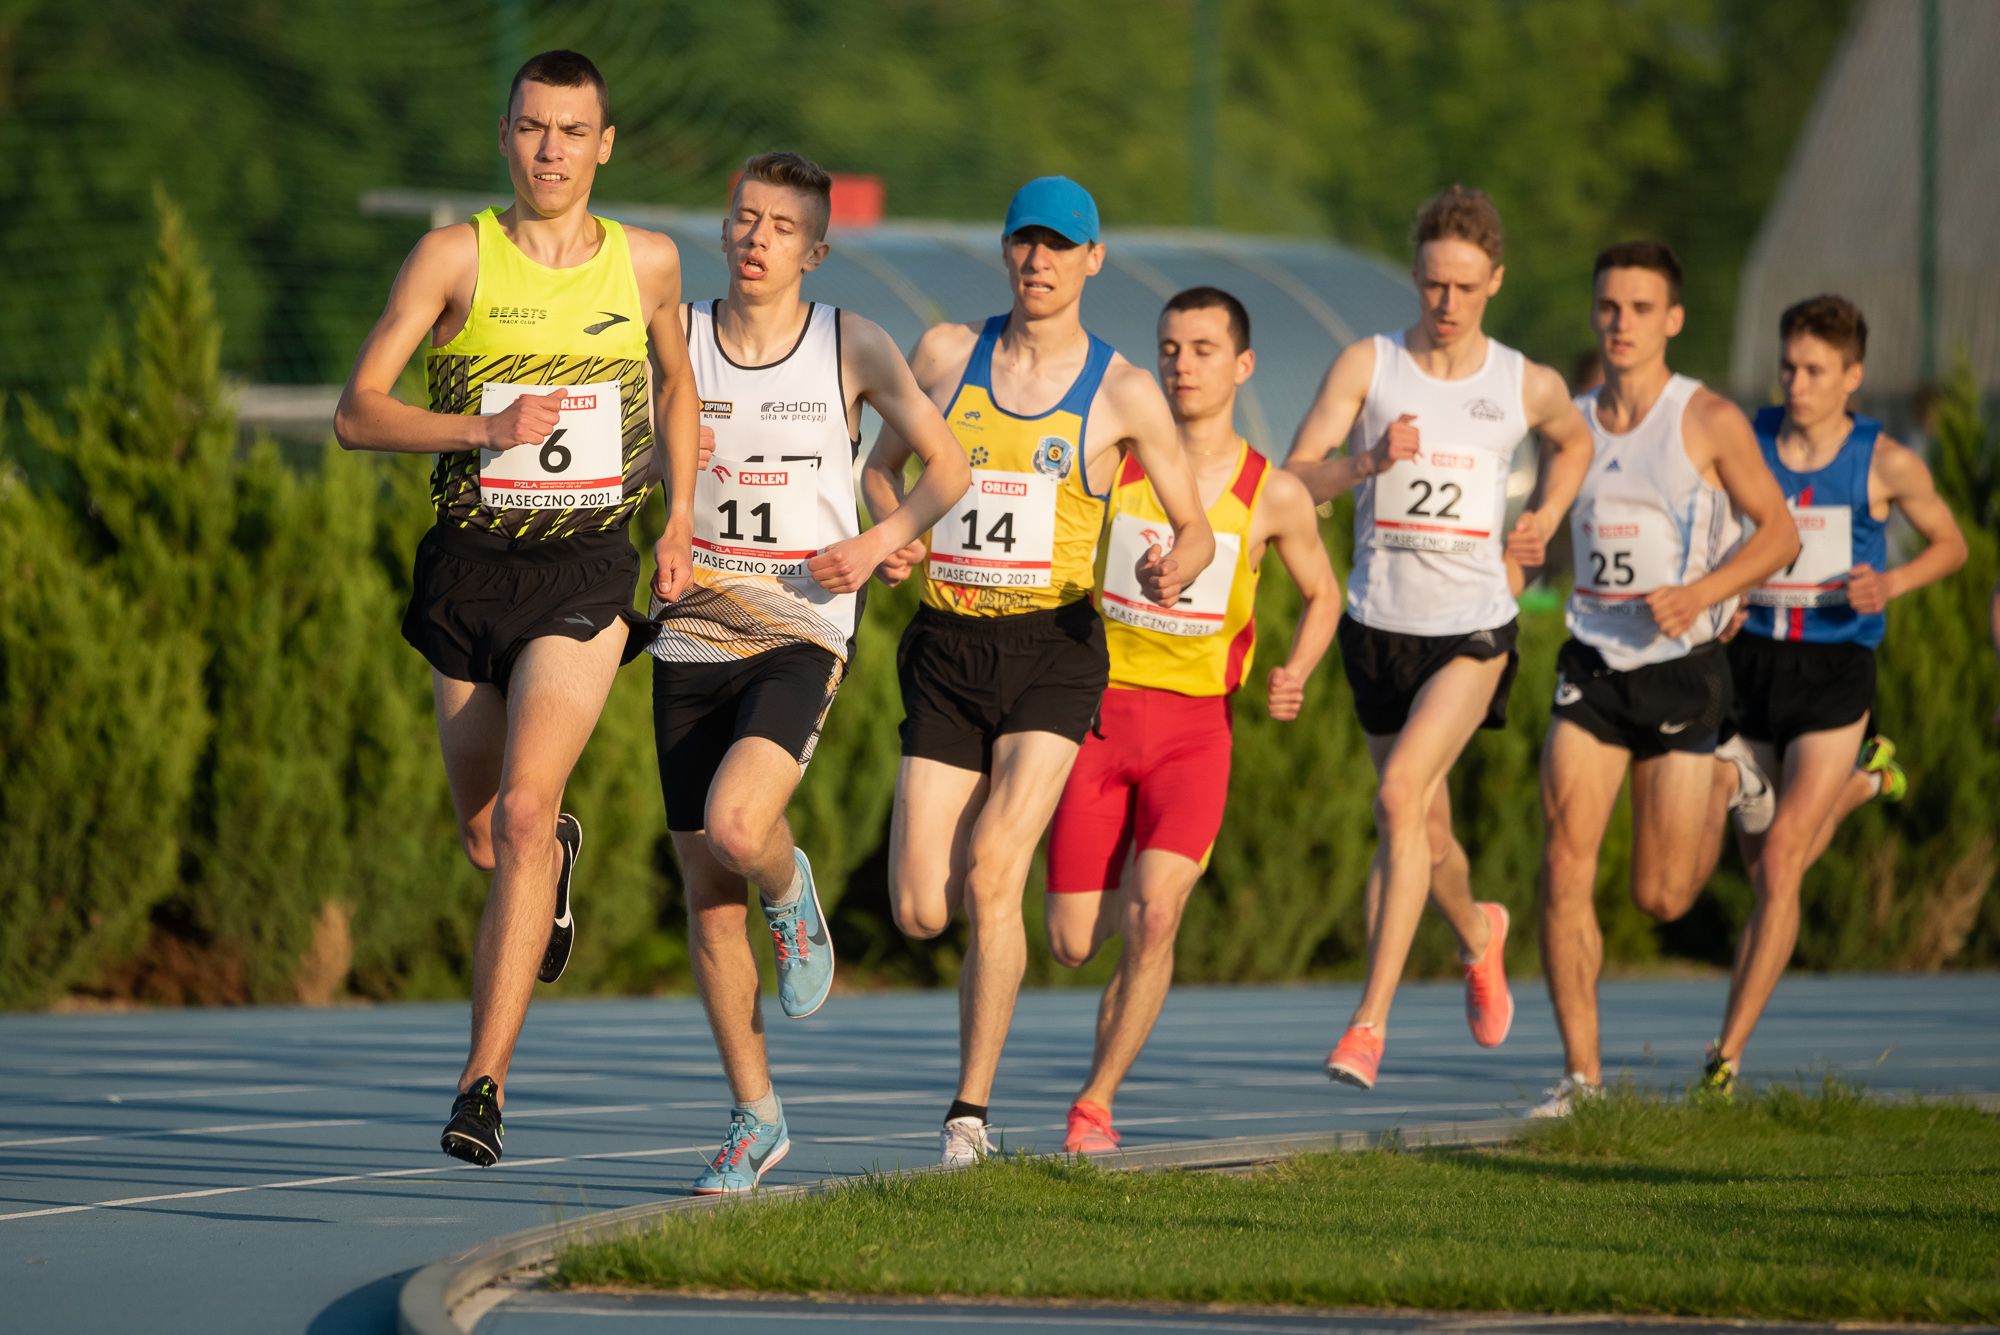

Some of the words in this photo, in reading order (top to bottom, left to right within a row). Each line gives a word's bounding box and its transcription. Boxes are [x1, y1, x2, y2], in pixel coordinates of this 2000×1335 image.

[489, 306, 548, 320] BEASTS
[560, 396, 595, 410] RLEN
[704, 402, 732, 412] OPTIMA
[760, 412, 777, 420] siła
[791, 414, 827, 423] precyzji
[538, 428, 572, 474] 6
[513, 481, 538, 489] PZLA
[741, 473, 786, 485] ORLEN
[982, 481, 1027, 496] ORLEN
[491, 493, 576, 507] PIASECZNO
[580, 492, 610, 506] 2021
[1405, 480, 1463, 520] 22
[717, 499, 778, 544] 11
[960, 509, 1017, 553] 14
[710, 544, 731, 554] PZLA
[692, 550, 766, 574] PIASECZNO
[770, 563, 802, 576] 2021
[1589, 551, 1635, 587] 25
[937, 566, 1002, 584] PIASECZNO
[1007, 573, 1036, 585] 2021
[1108, 605, 1178, 632] PIASECZNO
[1182, 623, 1210, 635] 2021
